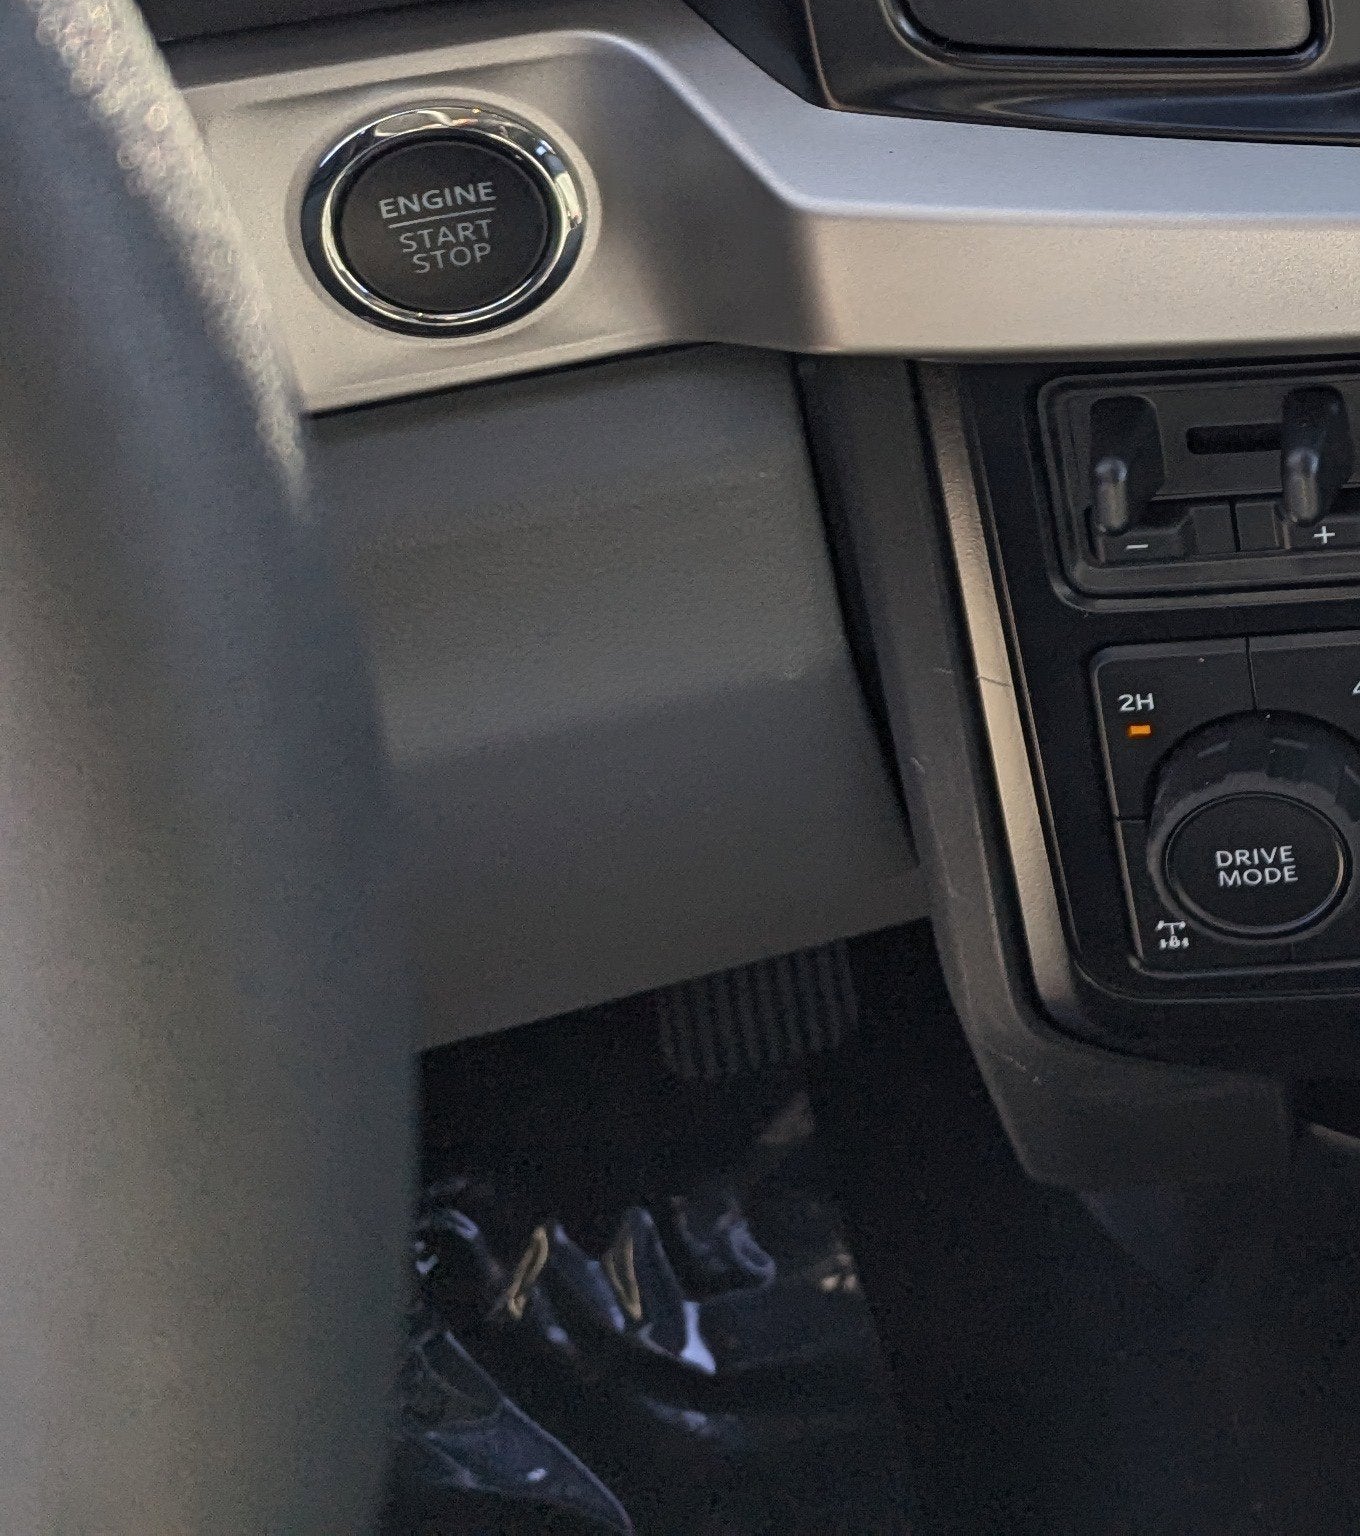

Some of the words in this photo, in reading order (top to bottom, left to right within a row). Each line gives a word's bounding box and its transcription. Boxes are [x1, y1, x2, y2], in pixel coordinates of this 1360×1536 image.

[378, 180, 498, 220] ENGINE
[399, 218, 493, 254] START
[412, 242, 492, 274] STOP
[1117, 692, 1155, 713] 2H
[1215, 844, 1295, 868] DRIVE
[1217, 864, 1299, 888] MODE
